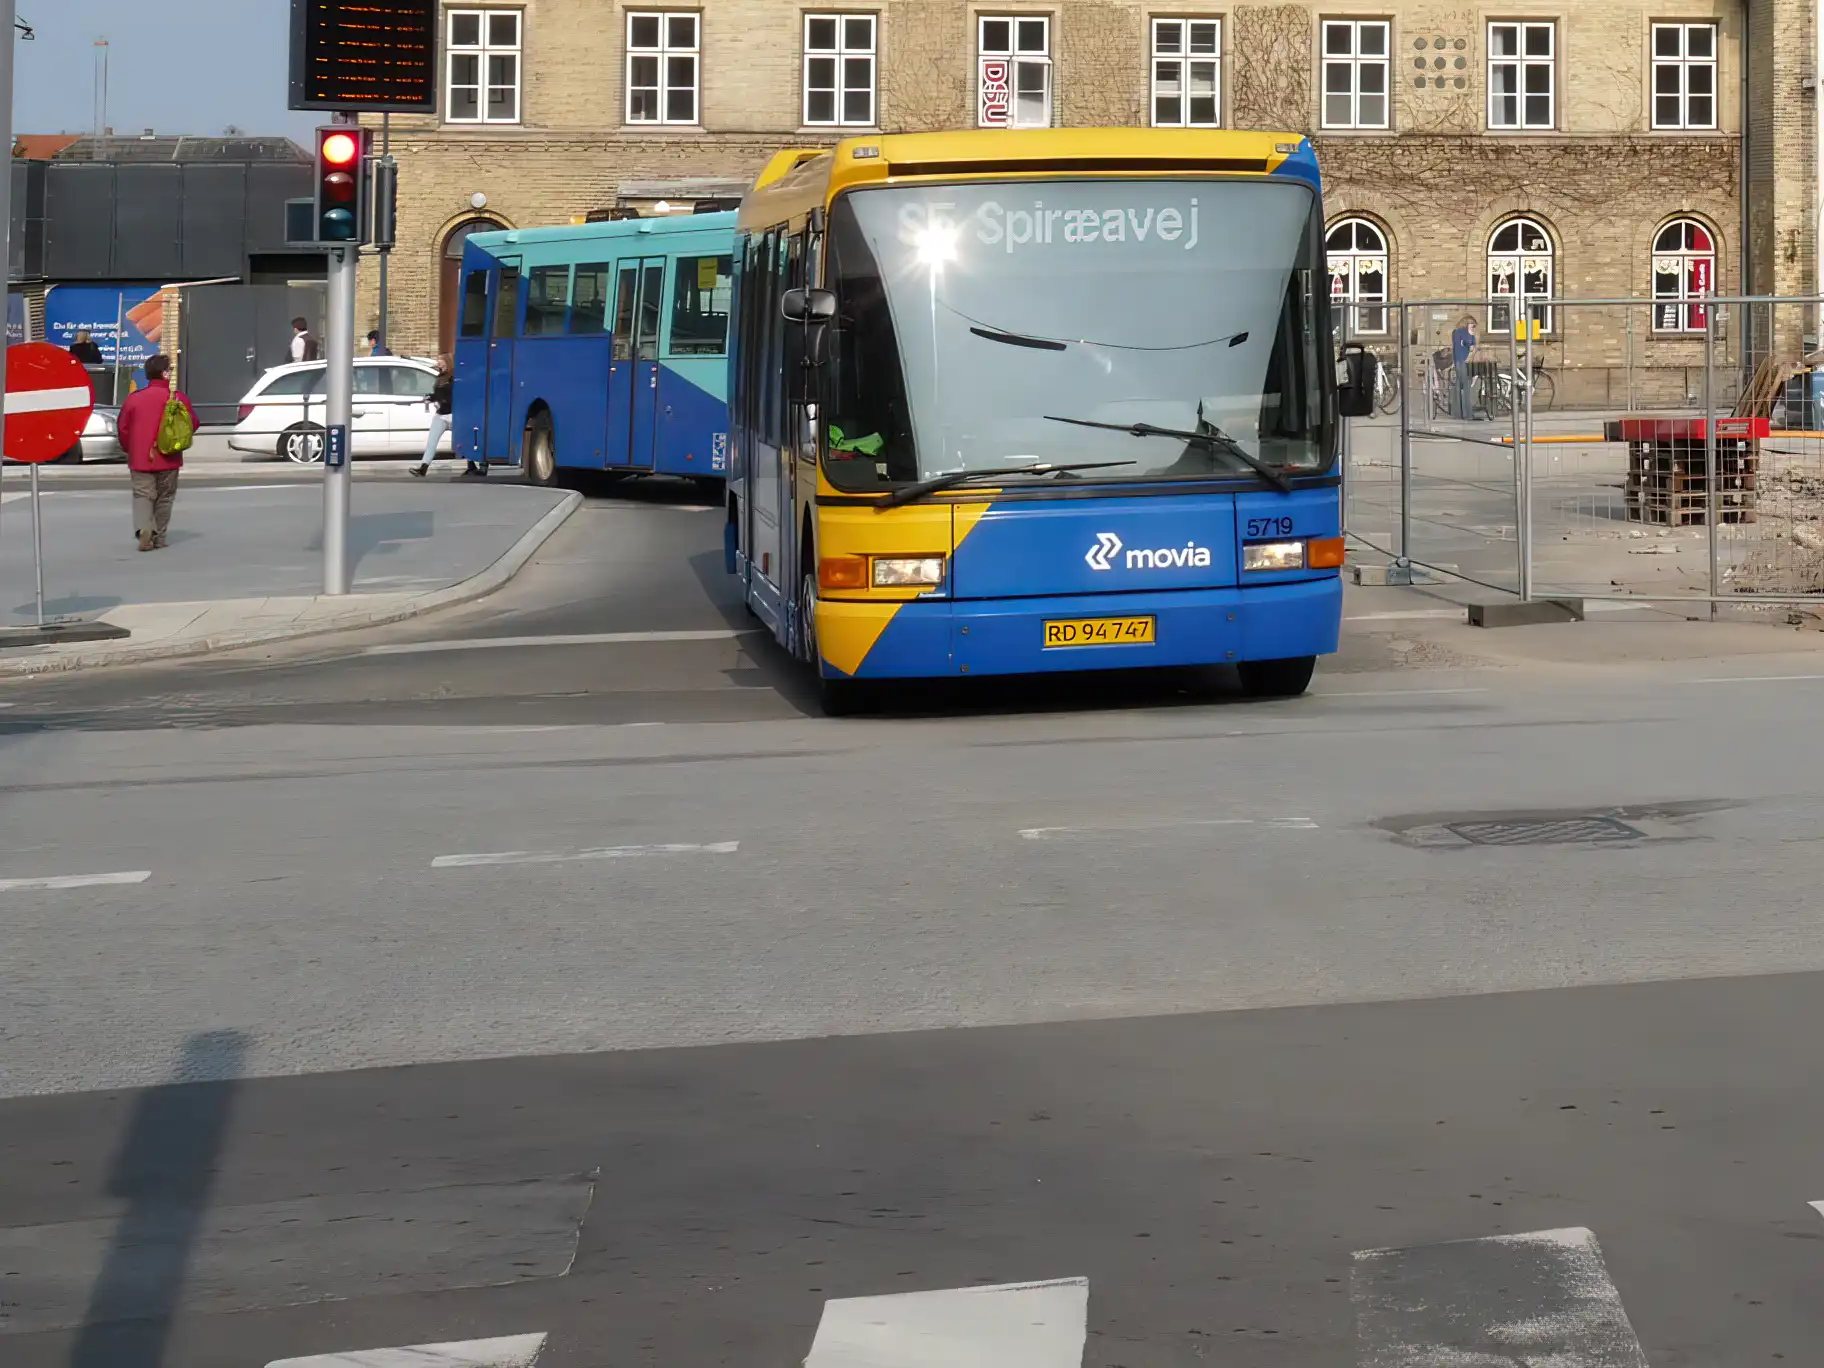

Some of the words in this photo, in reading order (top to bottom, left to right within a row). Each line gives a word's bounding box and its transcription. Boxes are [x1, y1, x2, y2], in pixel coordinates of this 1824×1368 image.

[983, 61, 1008, 123] DSU
[976, 197, 1199, 254] Spiræavej
[1246, 516, 1293, 537] 5719
[1126, 541, 1211, 569] movia
[1048, 624, 1077, 642] RD
[1082, 623, 1107, 641] 94
[1112, 620, 1149, 639] 747
